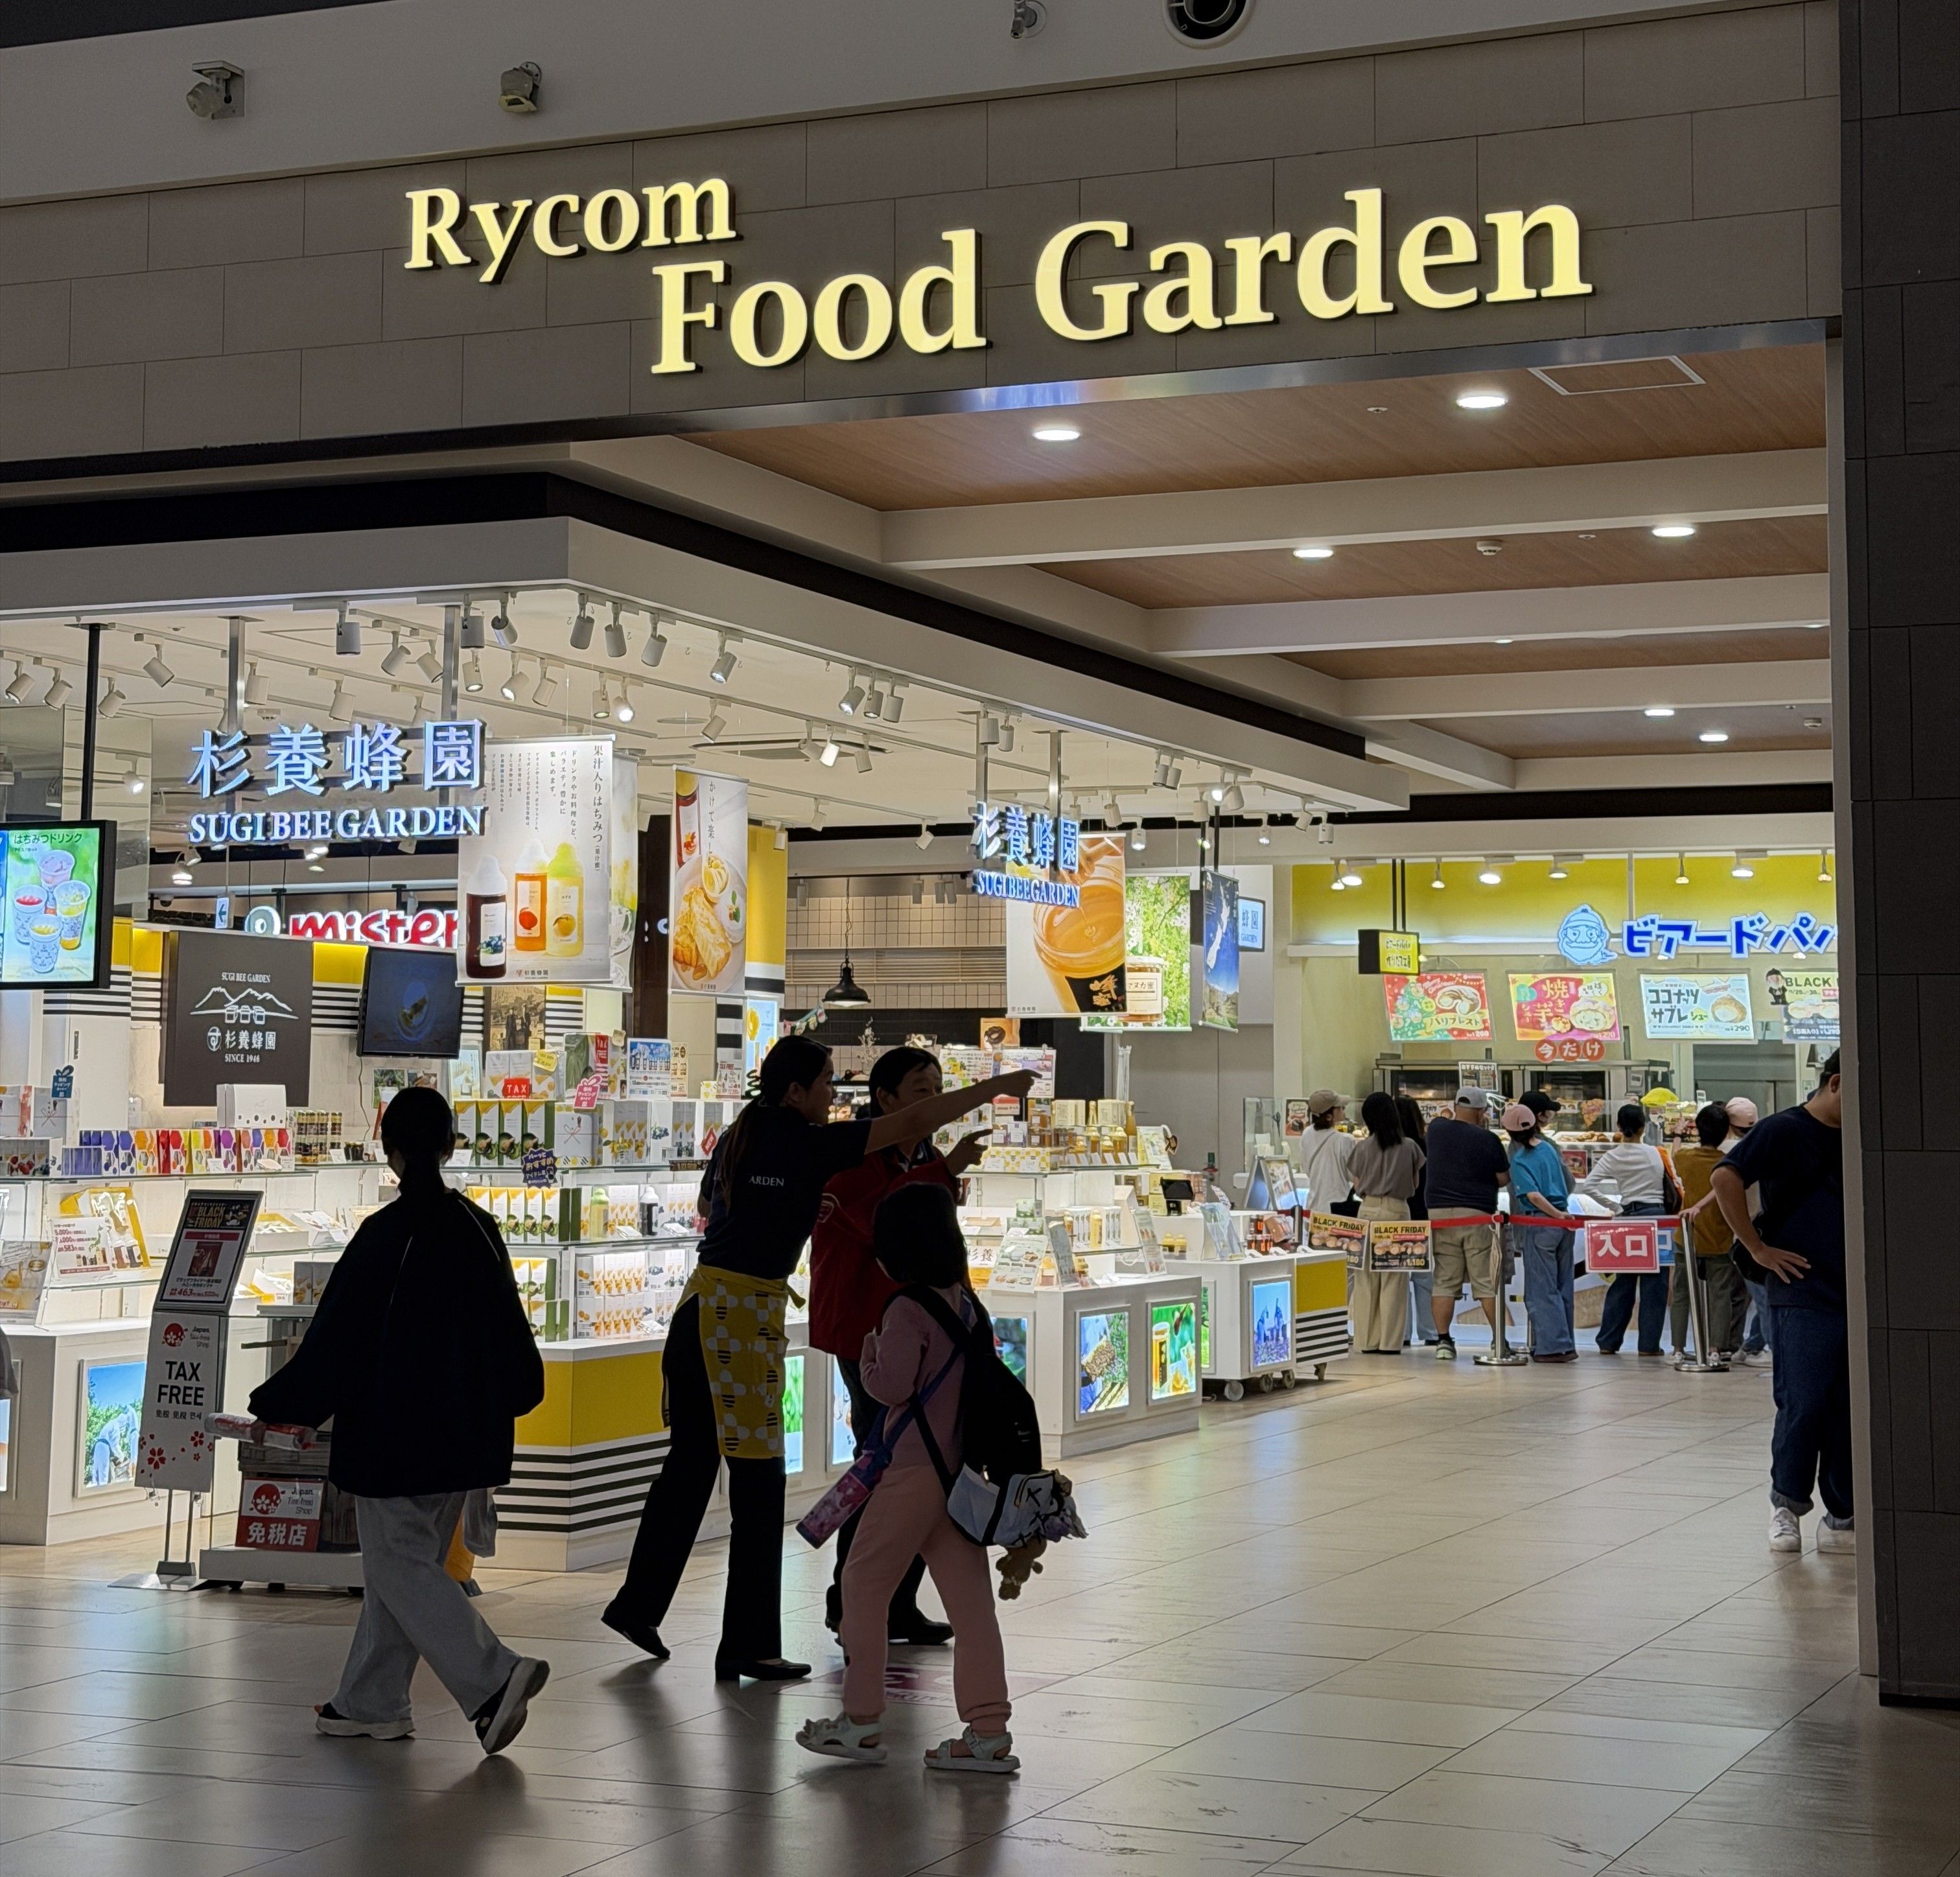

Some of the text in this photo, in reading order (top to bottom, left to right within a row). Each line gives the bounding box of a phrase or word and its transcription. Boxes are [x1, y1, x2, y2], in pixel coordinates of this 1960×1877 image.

[404, 178, 739, 283] Rycom
[651, 187, 1593, 374] Food Garden
[189, 719, 485, 799] 杉養蜂園
[188, 806, 485, 843] SUGI BEE GARDEN
[14, 832, 82, 844] はちみつドリンク
[970, 800, 1080, 875] 杉養蜂園
[976, 870, 1080, 908] SUGI BEE GARDEN
[289, 909, 459, 949] mister
[222, 972, 271, 983] SUGI BEE GARDEN
[1785, 977, 1832, 988] BLACK
[1648, 988, 1699, 1005] ココナッツ
[1429, 1016, 1480, 1027] パリブレスト
[1651, 1005, 1688, 1023] サブレ
[224, 1029, 276, 1050] 杉養蜂園
[225, 1053, 244, 1063] SINCE
[1538, 1041, 1601, 1058] 今だけ
[506, 1084, 527, 1093] TAX
[749, 1175, 785, 1187] ARDEN
[197, 1206, 226, 1217] BLACK
[194, 1217, 224, 1228] FRIDAY
[1313, 1216, 1365, 1231] BLACK FRIDAY
[1400, 1226, 1427, 1234] FRIDAY
[1596, 1234, 1648, 1257] 入口
[1347, 1254, 1359, 1264] 180
[165, 1360, 201, 1382] TAX
[157, 1384, 205, 1406] FREE
[295, 1506, 313, 1515] Shop
[247, 1521, 308, 1546] 免税店
